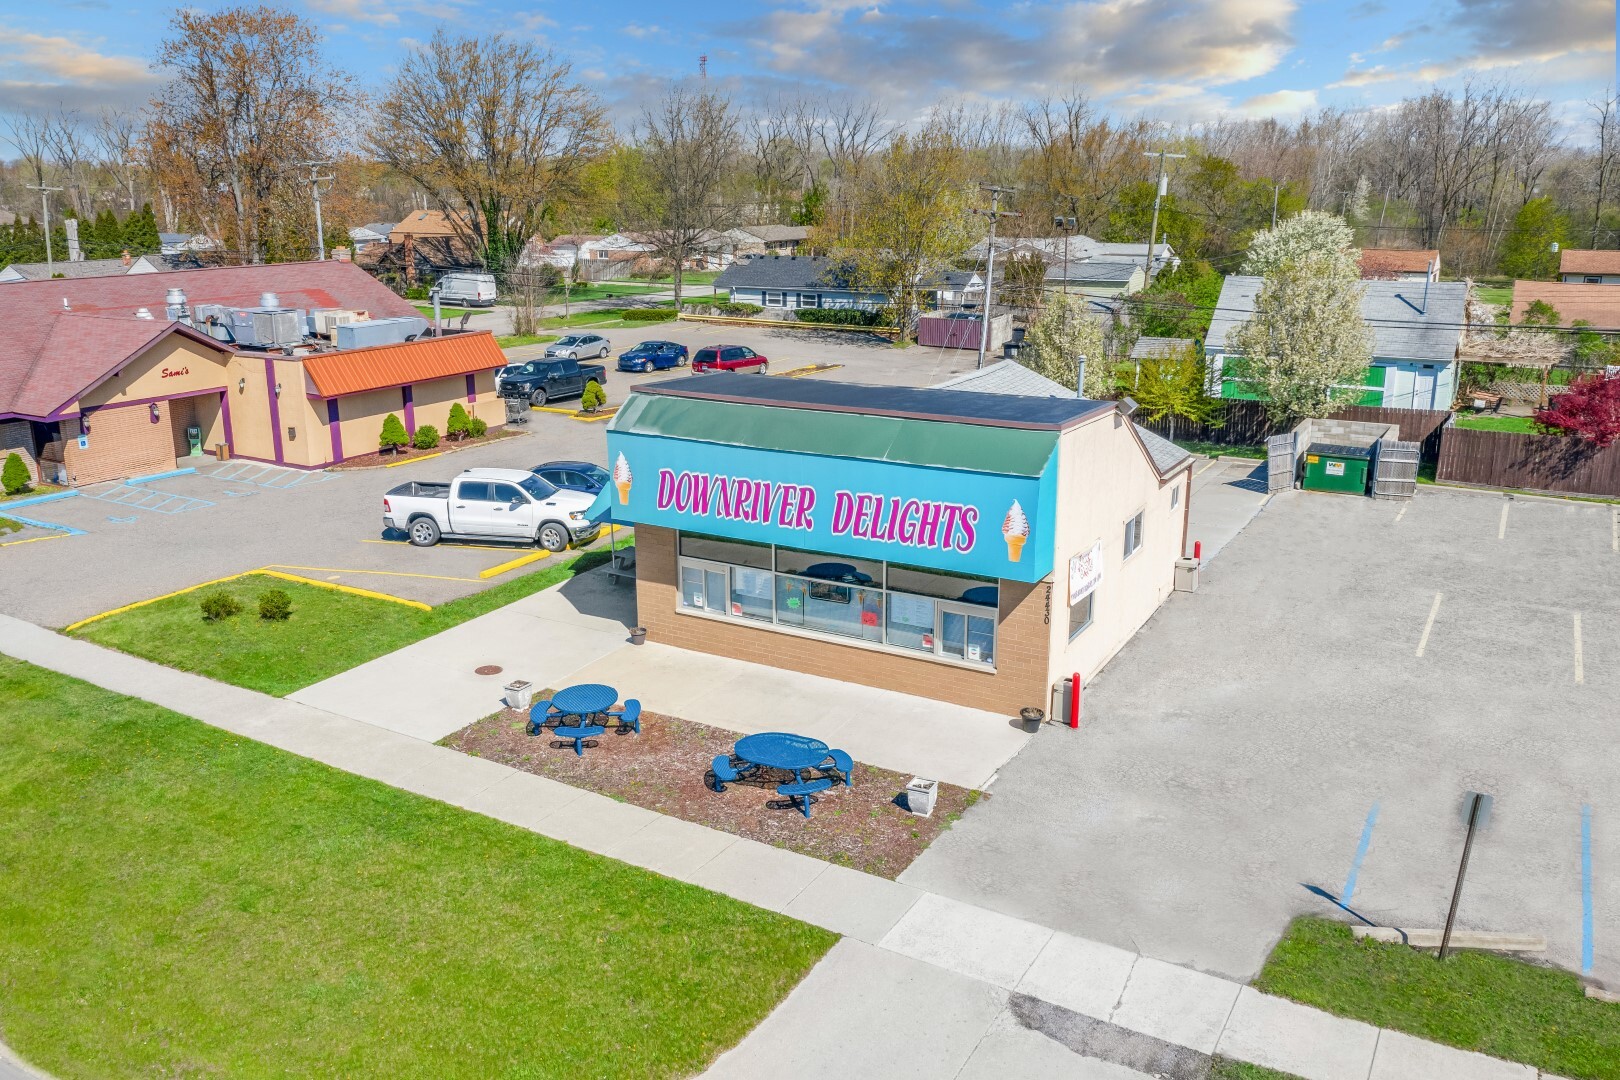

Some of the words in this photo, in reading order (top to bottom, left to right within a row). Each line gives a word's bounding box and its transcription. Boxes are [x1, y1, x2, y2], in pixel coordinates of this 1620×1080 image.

[161, 366, 189, 378] Sami's
[657, 469, 815, 530] DOWNRIVER
[832, 491, 978, 554] DELIGHTS
[1043, 585, 1052, 625] 24430
